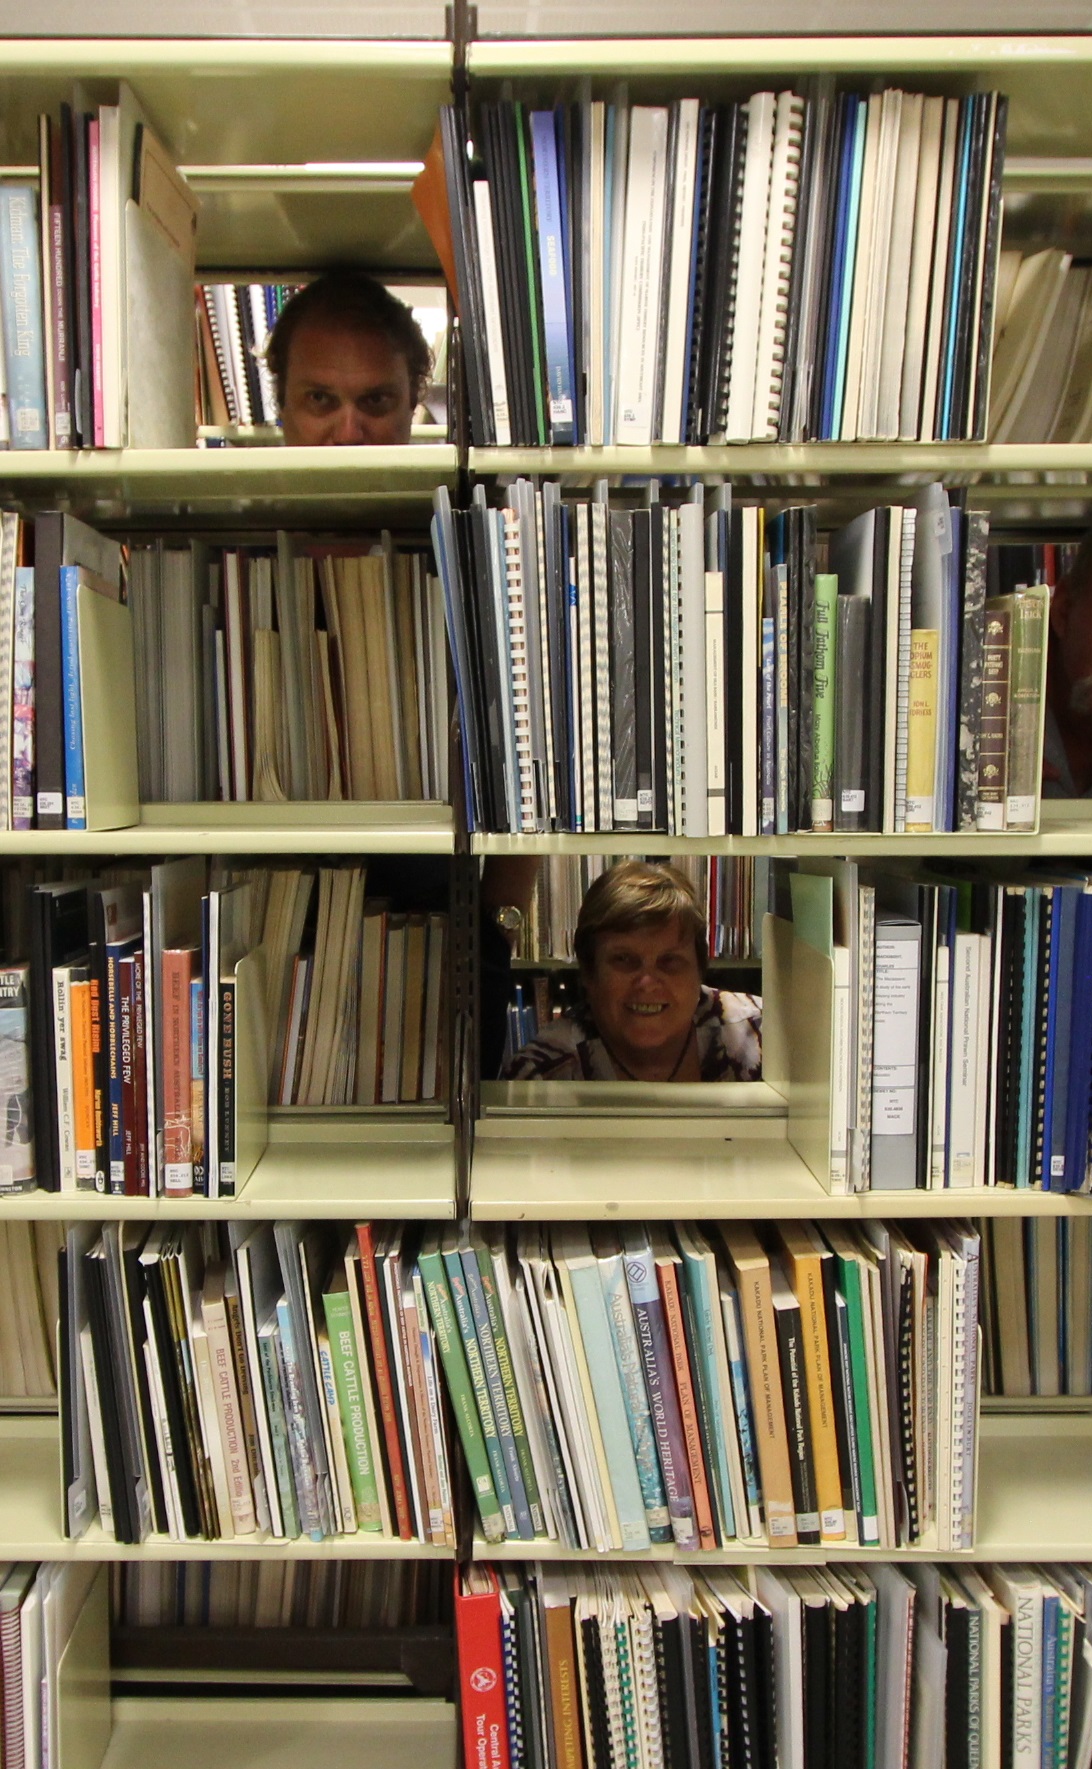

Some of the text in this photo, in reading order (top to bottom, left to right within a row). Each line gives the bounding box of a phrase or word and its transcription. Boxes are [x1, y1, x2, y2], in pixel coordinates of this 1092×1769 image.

[53, 212, 62, 245] FIFTEEN
[9, 196, 34, 356] Kidman: The Forgotten King
[54, 247, 64, 286] HUNDRED
[547, 235, 557, 276] SEAFOOD
[815, 601, 830, 698] Full Fathom Five
[914, 642, 928, 650] THE
[135, 979, 142, 989] OF
[58, 1017, 66, 1033] yer
[91, 979, 101, 1053] Red Dust Rising
[223, 992, 232, 1079] GONE BUSH
[59, 1037, 68, 1061] swag
[109, 1021, 117, 1079] HOBBLECHAINS
[121, 996, 131, 1084] THE PRIVILEGED FEW
[961, 1059, 969, 1086] Seminar
[230, 1304, 241, 1329] Angels
[427, 1281, 451, 1354] NORTHERN TERRITORY
[753, 1282, 775, 1439] KAKADU NATIONAL PARK PLAN OF MANAGEMENT
[788, 1337, 796, 1347] The
[789, 1349, 798, 1371] Potential
[807, 1273, 827, 1429] KAKADU NATIONAL PARK PLAN OF MANAGEMENT
[320, 1350, 335, 1406] CATTLE CAMP
[454, 1294, 496, 1438] Australia's NORTHERN TERRITORY
[477, 1323, 499, 1378] NORTHERN
[491, 1381, 512, 1438] TERRITORY
[485, 1292, 524, 1438] Australia's NORTHERN TERRITORY
[664, 1280, 702, 1485] KAKADU NATIONAL PARK PLAN OF MANAGEMENT
[338, 1331, 370, 1475] BEEF CATTLE PRODUCTION
[429, 1402, 437, 1417] Dairy
[460, 1394, 468, 1414] FRANK
[636, 1308, 679, 1502] AUSTRALIA'S WORLD HERITAGE
[792, 1389, 801, 1407] Kakadu
[794, 1408, 803, 1429] National
[215, 1349, 243, 1498] BEEF CATTLE PRODUCTION 2nd Editio
[796, 1430, 804, 1441] Park
[492, 1450, 500, 1469] FRANK
[969, 1616, 979, 1675] NATIONAL
[559, 1660, 572, 1715] INTERESTS
[969, 1677, 979, 1712] PARKS
[1016, 1597, 1033, 1754] NATIONAL PARKS
[476, 1714, 486, 1735] Tour
[490, 1724, 500, 1758] Central
[969, 1716, 979, 1731] OF
